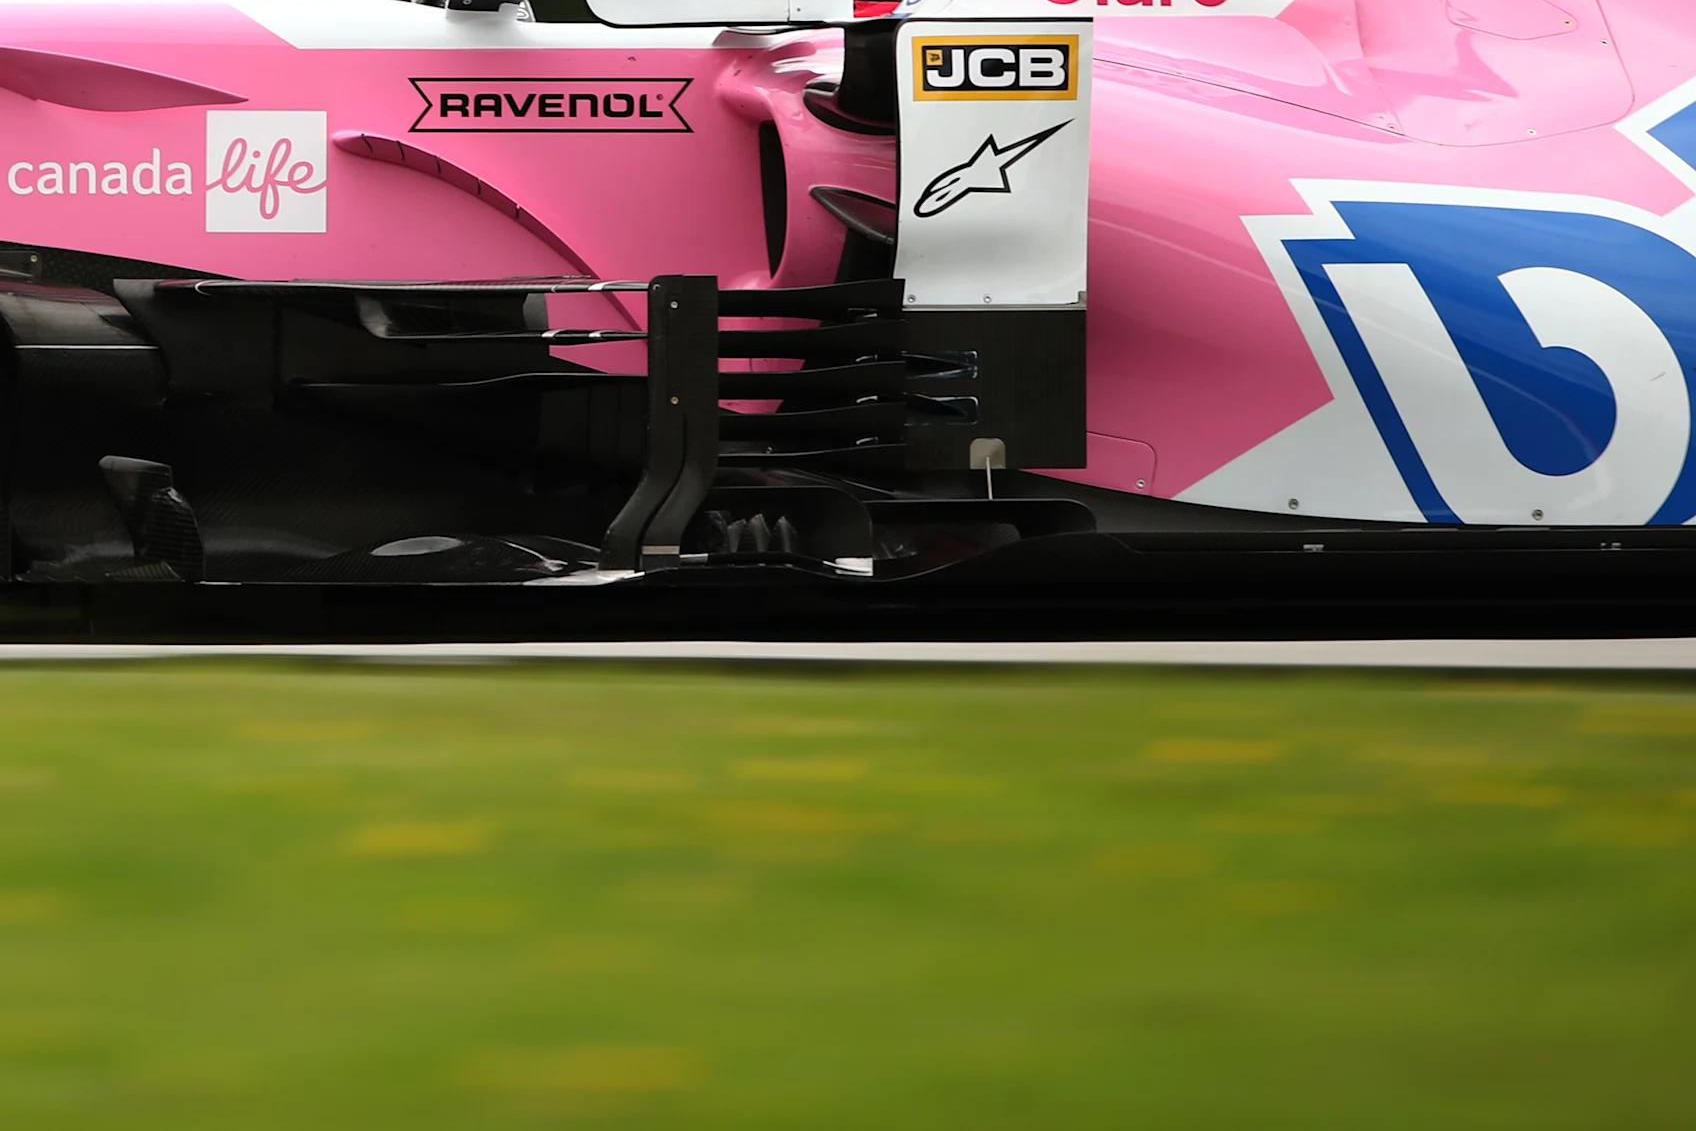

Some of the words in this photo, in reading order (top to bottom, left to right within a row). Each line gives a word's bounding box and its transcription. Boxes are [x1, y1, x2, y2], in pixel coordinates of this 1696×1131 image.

[926, 48, 1066, 88] JCB
[440, 93, 663, 118] RAVENOL
[7, 147, 193, 195] canada
[206, 137, 327, 220] life
